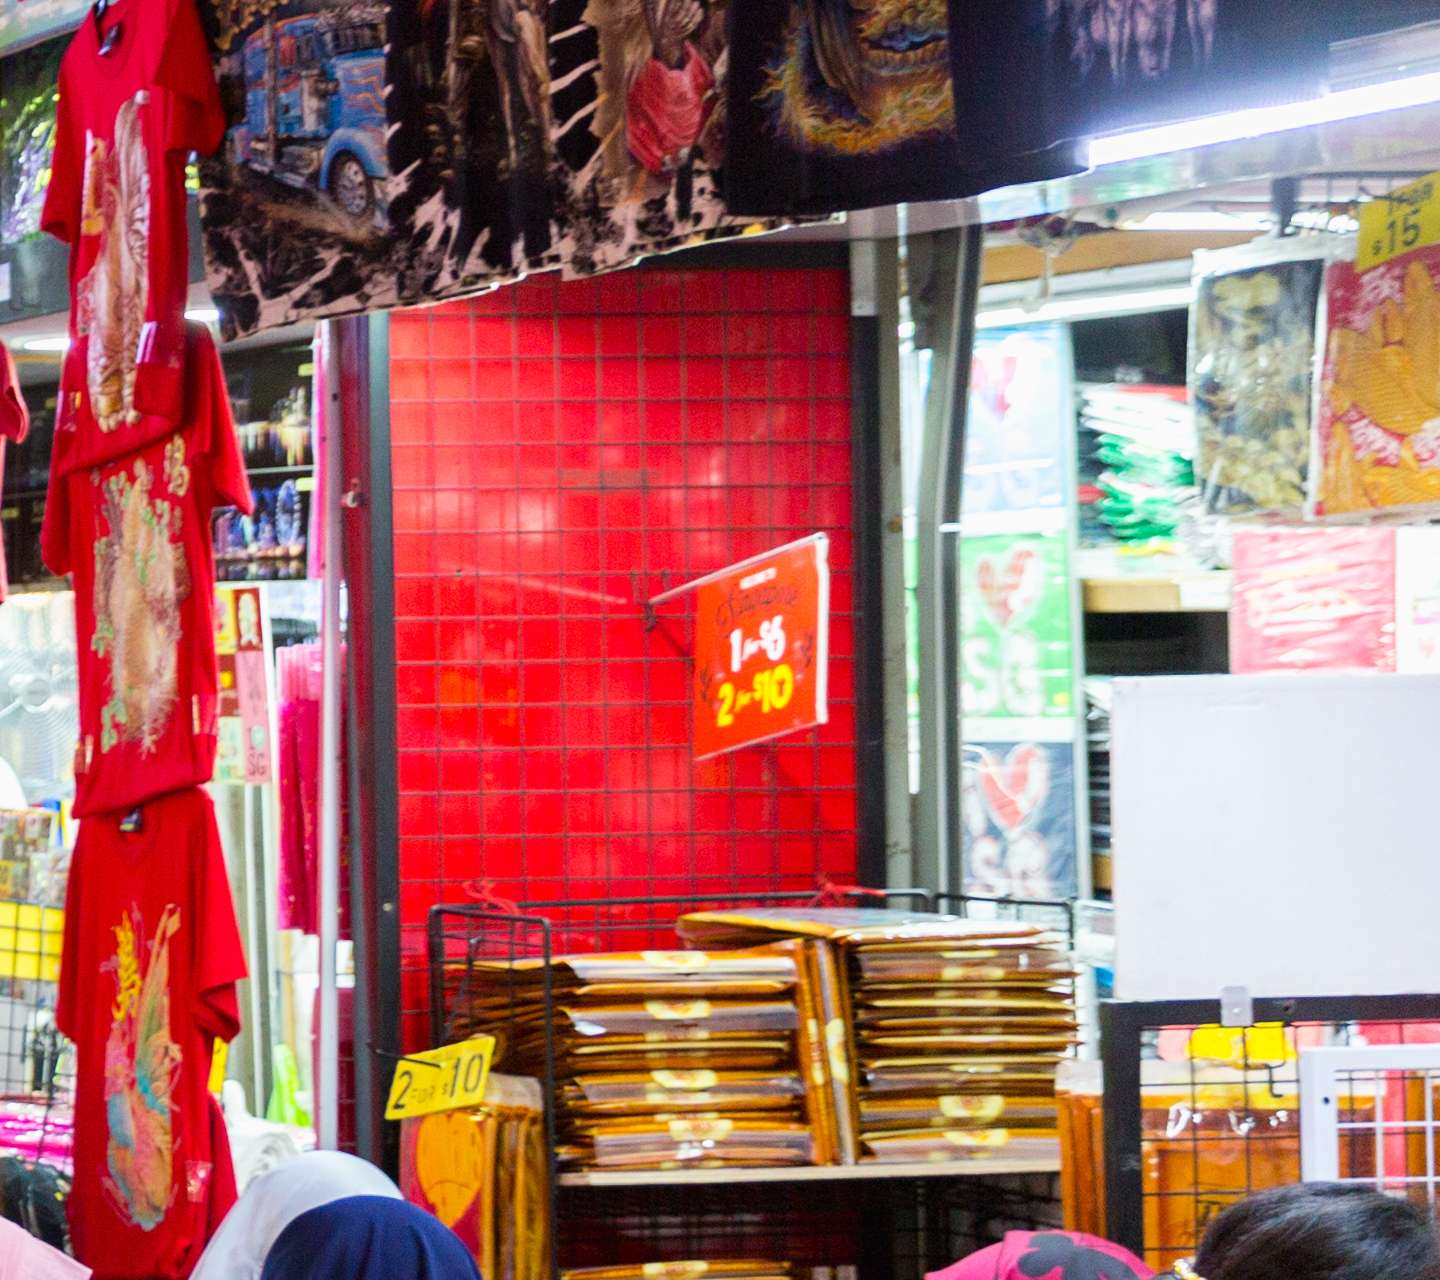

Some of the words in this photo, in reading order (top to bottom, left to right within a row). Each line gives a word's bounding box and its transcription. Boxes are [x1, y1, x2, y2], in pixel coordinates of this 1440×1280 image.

[730, 629, 742, 671] 1
[717, 683, 734, 727] 2
[392, 1070, 413, 1110] 2
